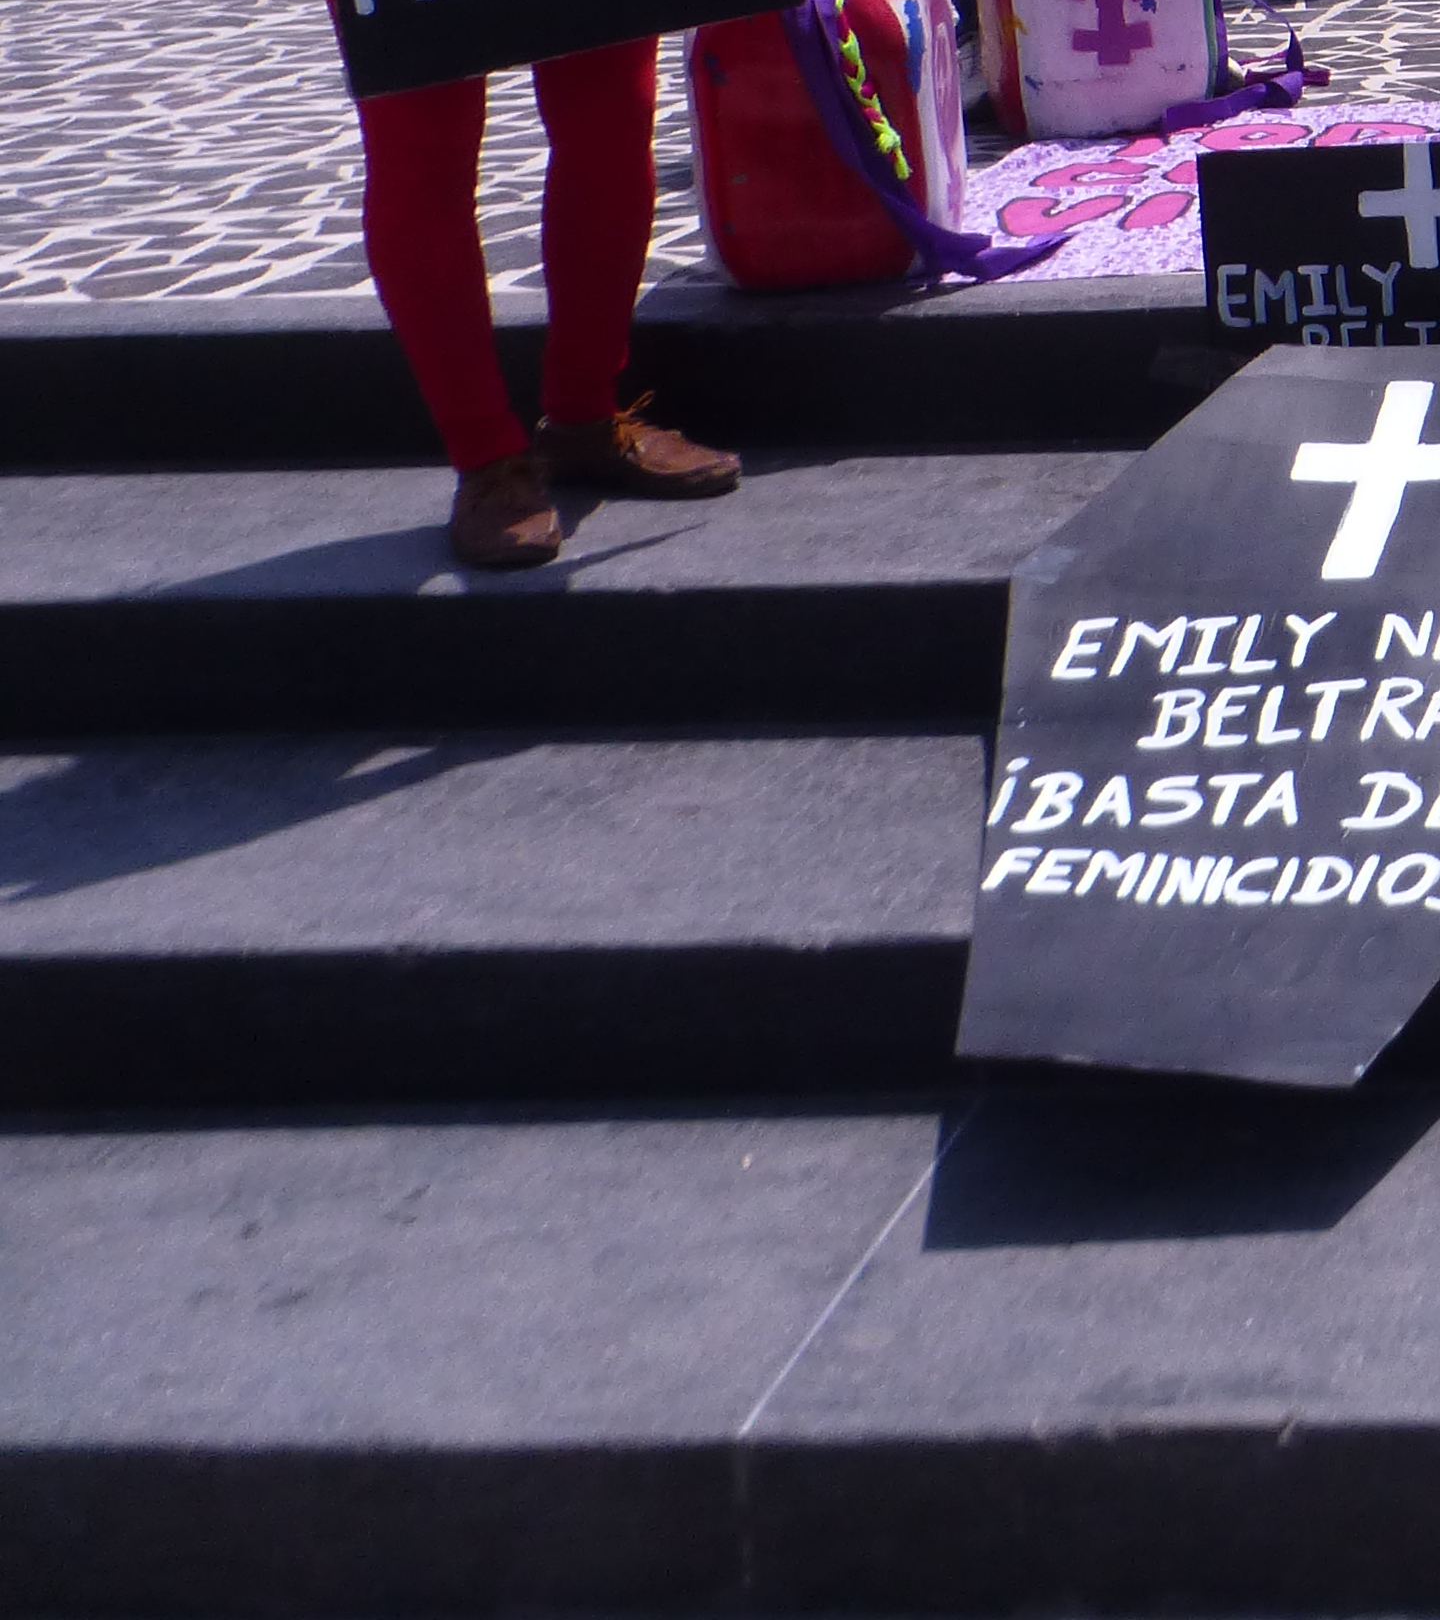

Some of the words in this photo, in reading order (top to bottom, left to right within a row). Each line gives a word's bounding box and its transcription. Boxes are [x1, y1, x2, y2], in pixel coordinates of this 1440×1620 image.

[1216, 261, 1402, 329] EMILY
[1051, 611, 1338, 680] EMILY
[986, 756, 1298, 834] ¡BASTA
